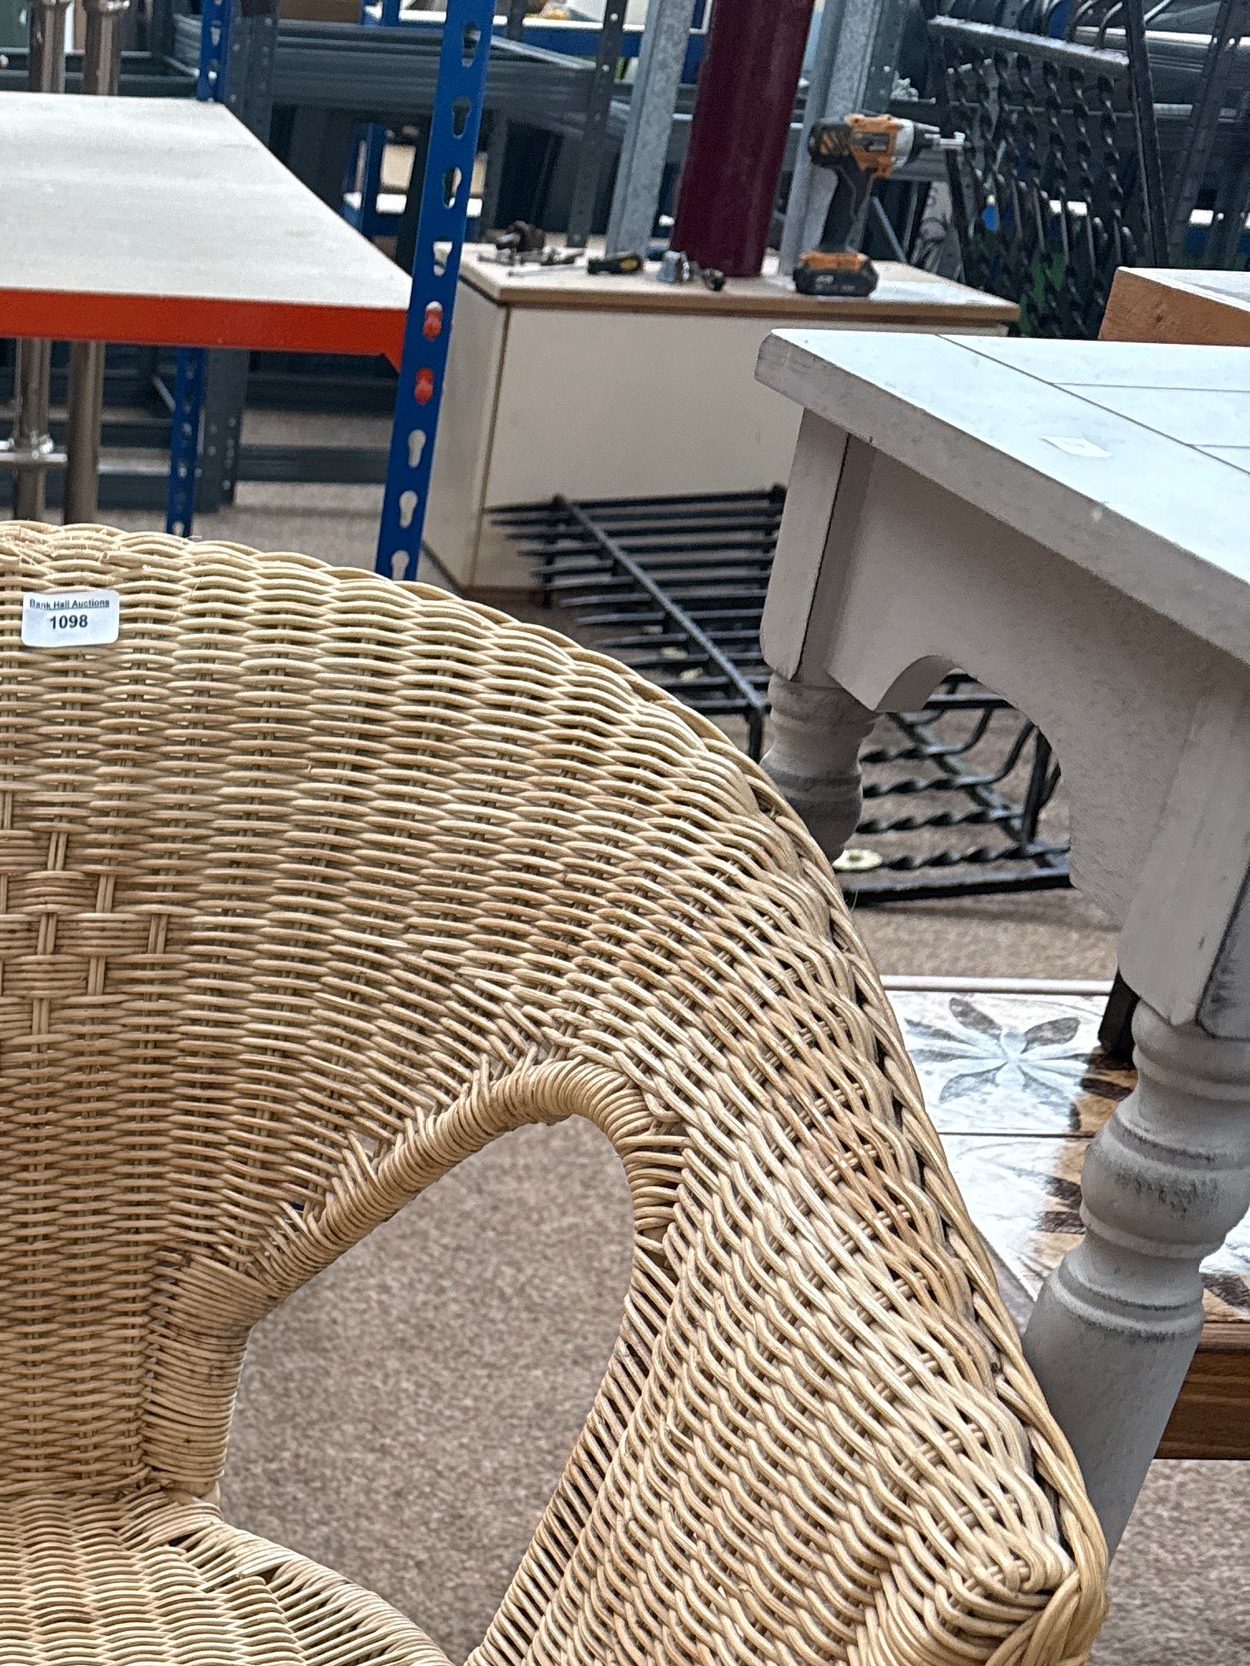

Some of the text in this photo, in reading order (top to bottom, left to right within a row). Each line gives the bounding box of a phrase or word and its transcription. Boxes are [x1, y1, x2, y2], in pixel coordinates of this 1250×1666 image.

[29, 598, 110, 610] Bank Hall Auctions
[49, 614, 88, 630] 1098
